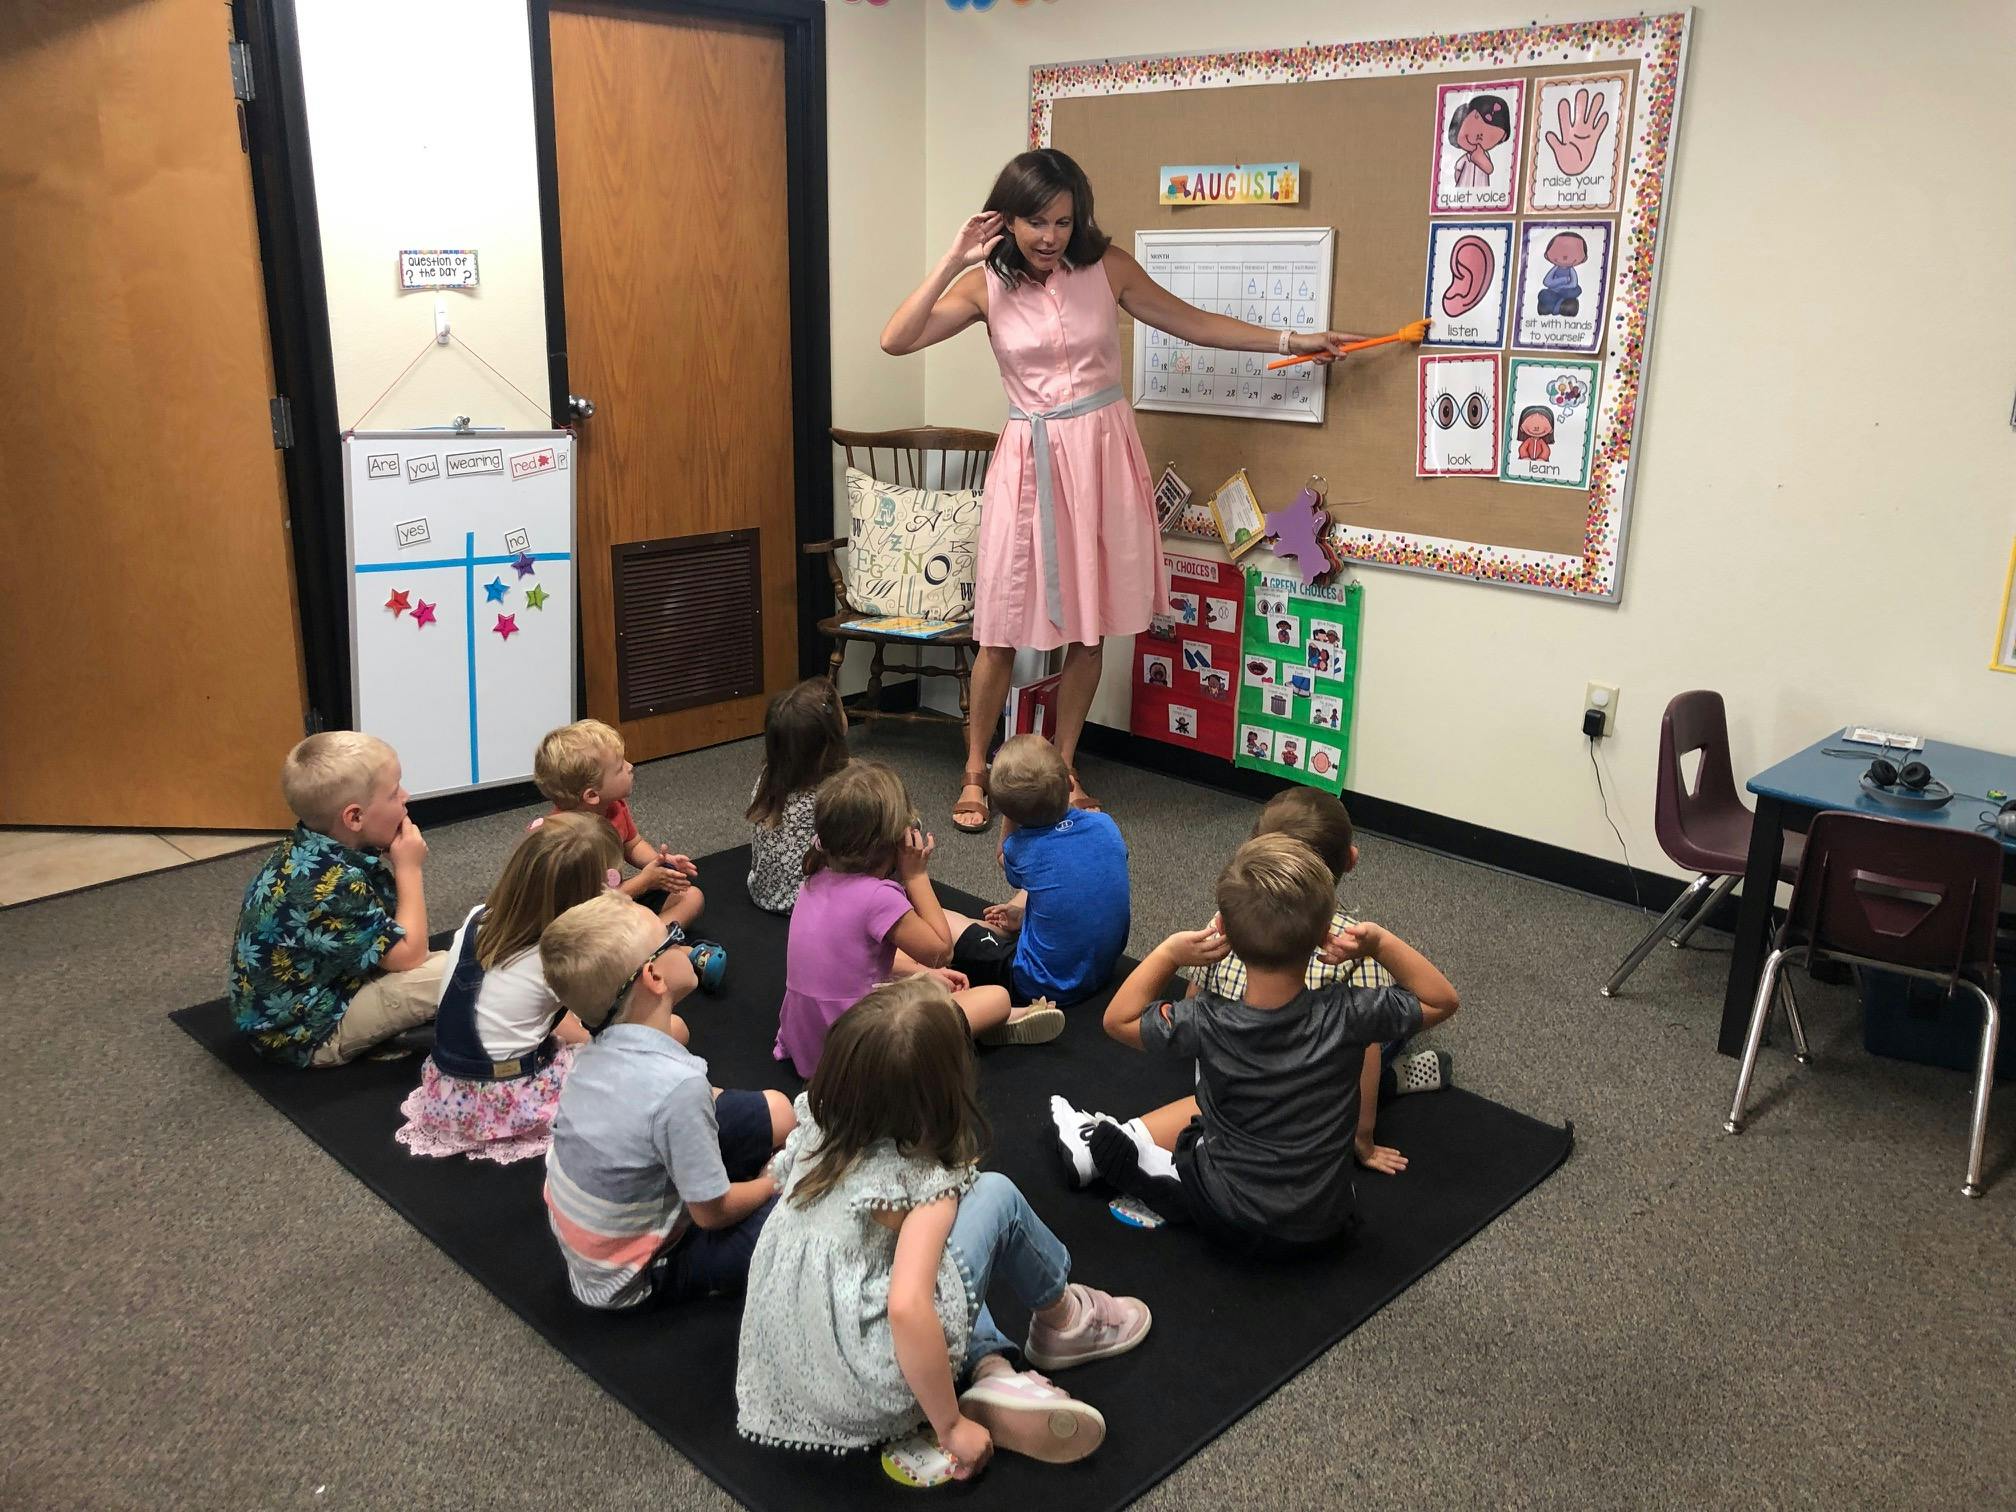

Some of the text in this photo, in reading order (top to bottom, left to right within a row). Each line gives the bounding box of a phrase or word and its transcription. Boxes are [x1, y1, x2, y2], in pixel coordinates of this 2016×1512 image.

[1192, 170, 1278, 201] AUGUST
[1542, 175, 1605, 189] raise your
[1440, 190, 1507, 204] quiet voice
[1557, 190, 1587, 202] hand
[419, 267, 436, 278] the
[1283, 316, 1288, 325] 9
[1306, 316, 1314, 324] 10
[1524, 318, 1593, 331] sit with hands
[1447, 324, 1479, 337] listen
[1530, 330, 1586, 343] to yourself
[1161, 363, 1168, 371] 18
[1252, 368, 1261, 376] 22
[1277, 369, 1286, 377] 23
[1226, 389, 1236, 398] 28
[1248, 391, 1258, 399] 29
[1271, 392, 1283, 400] 30
[371, 458, 398, 472] Are
[410, 461, 437, 478] you
[449, 454, 500, 470] wearing
[513, 456, 537, 473] red
[1447, 452, 1472, 466] look
[1528, 460, 1560, 476] learn
[400, 524, 426, 545] yes
[509, 534, 525, 547] no
[902, 551, 924, 575] N
[924, 552, 953, 586] O
[1176, 560, 1210, 578] CHOICES
[1300, 582, 1337, 600] CHOICES
